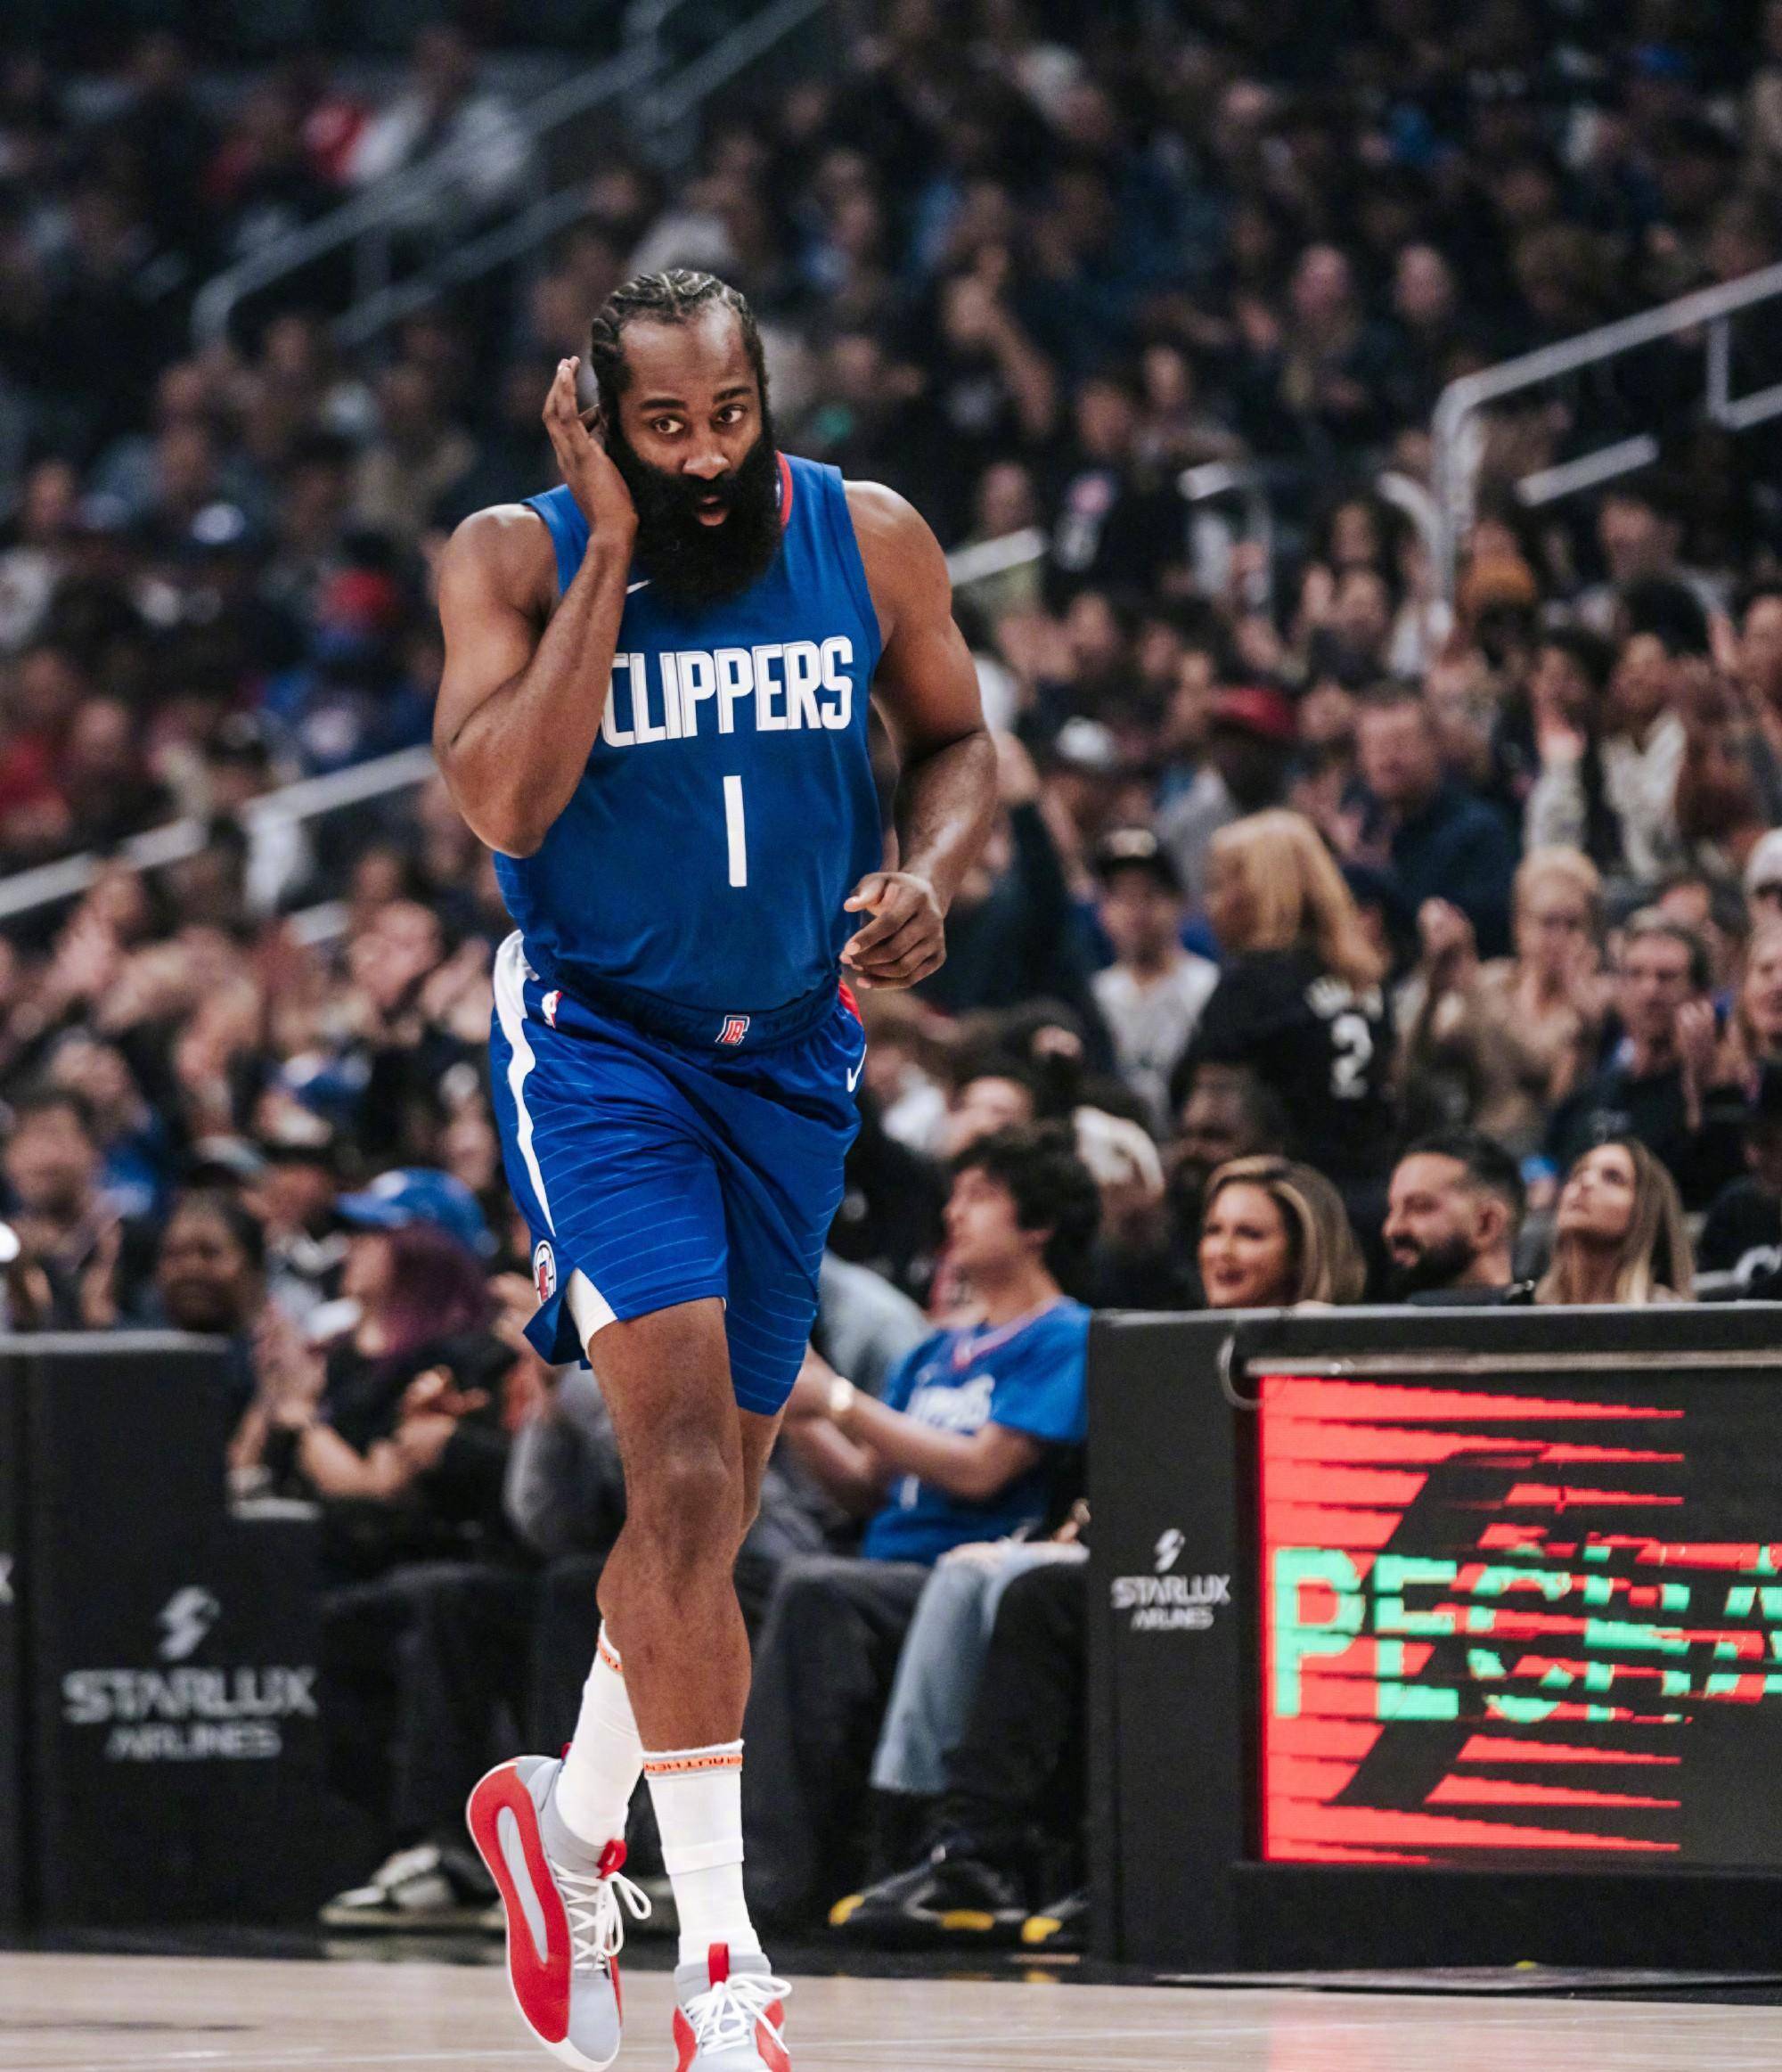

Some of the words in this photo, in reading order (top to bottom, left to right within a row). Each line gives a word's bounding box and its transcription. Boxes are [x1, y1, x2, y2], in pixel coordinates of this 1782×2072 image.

[601, 635, 853, 747] CLIPPERS
[723, 774, 748, 887] 1
[1331, 1012, 1372, 1099] 2
[1111, 1574, 1231, 1609] STARLUX
[1131, 1606, 1214, 1631] AIRLINES
[62, 1667, 317, 1724] STARLUX
[106, 1722, 282, 1760] AIRLINES
